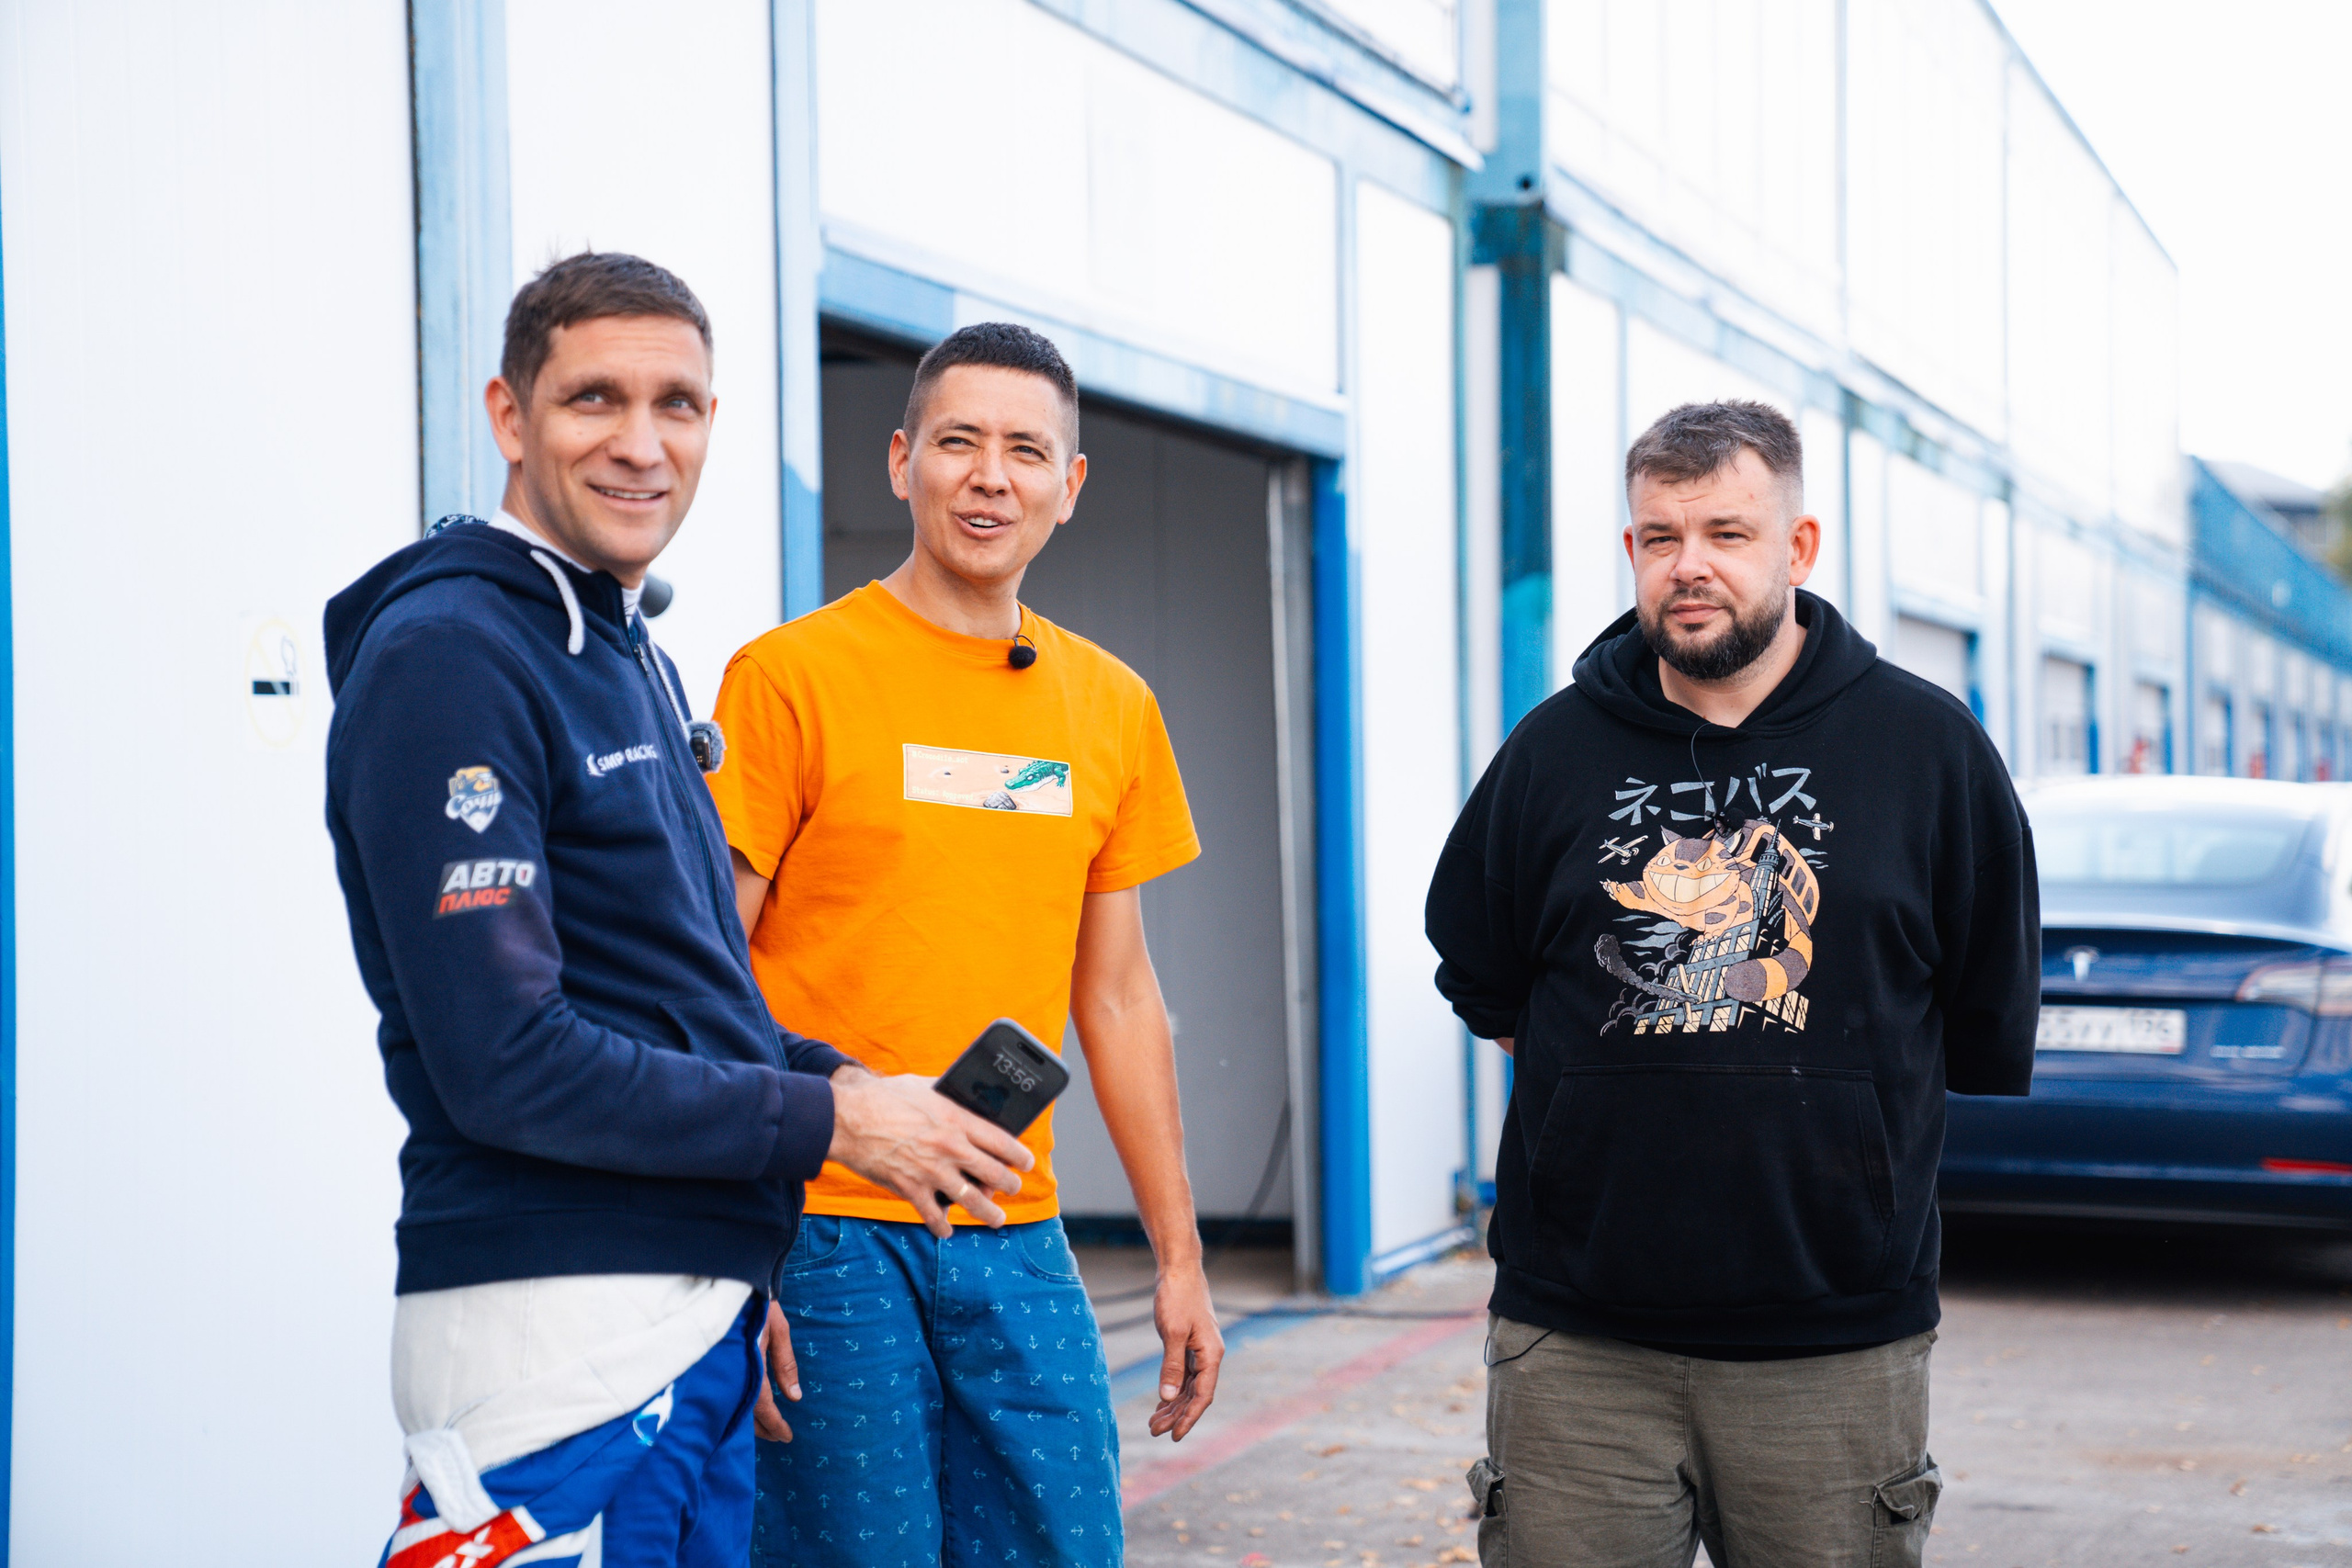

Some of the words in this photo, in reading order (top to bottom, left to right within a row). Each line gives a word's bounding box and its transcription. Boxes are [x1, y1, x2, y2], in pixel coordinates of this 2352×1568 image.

[597, 750, 625, 772] SMP
[1608, 762, 1817, 825] ネコバス
[442, 861, 536, 893] АВТО
[439, 886, 511, 914] ПЛЮС
[992, 1054, 1035, 1092] 13:56
